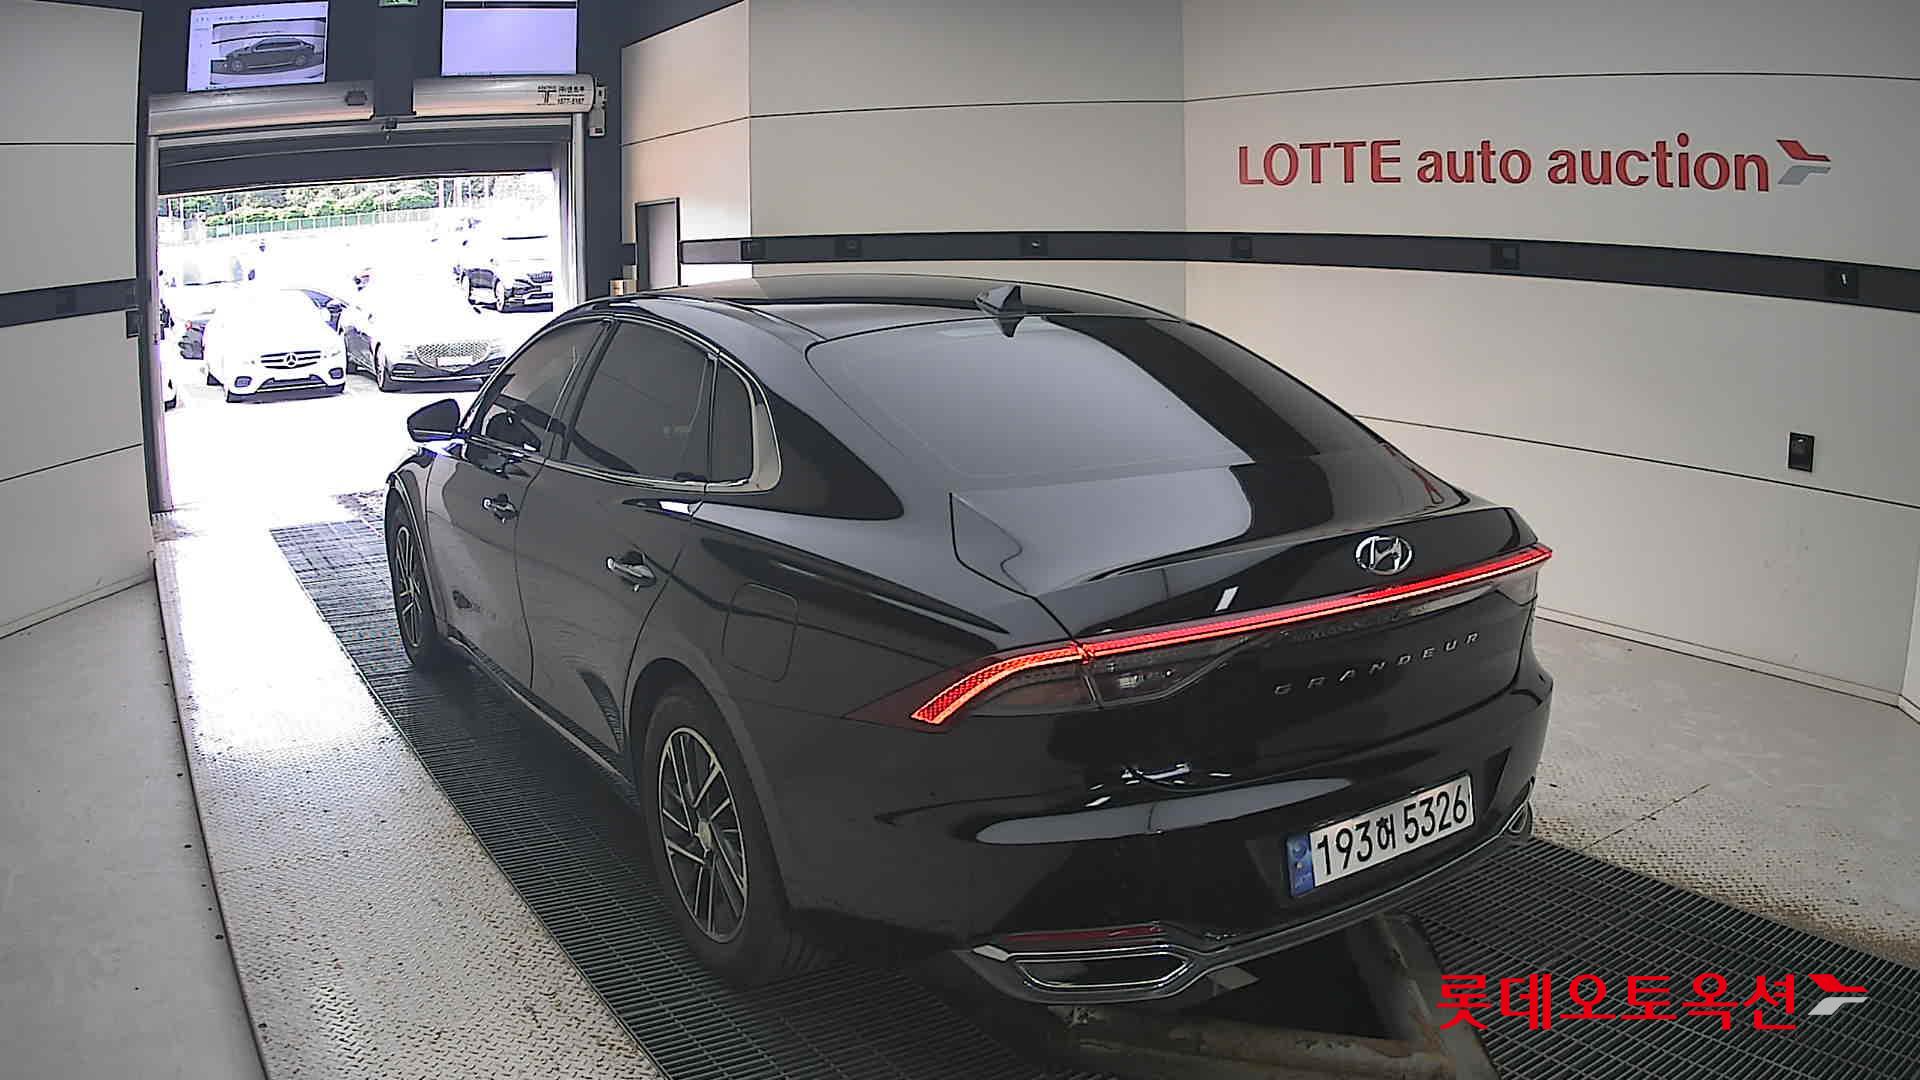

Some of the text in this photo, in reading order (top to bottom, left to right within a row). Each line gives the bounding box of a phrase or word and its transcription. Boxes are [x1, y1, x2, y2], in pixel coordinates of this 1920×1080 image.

[1238, 133, 1770, 191] LOTTE auto auction
[1273, 631, 1481, 696] GRANDEUR
[1316, 784, 1468, 876] 193허 5326
